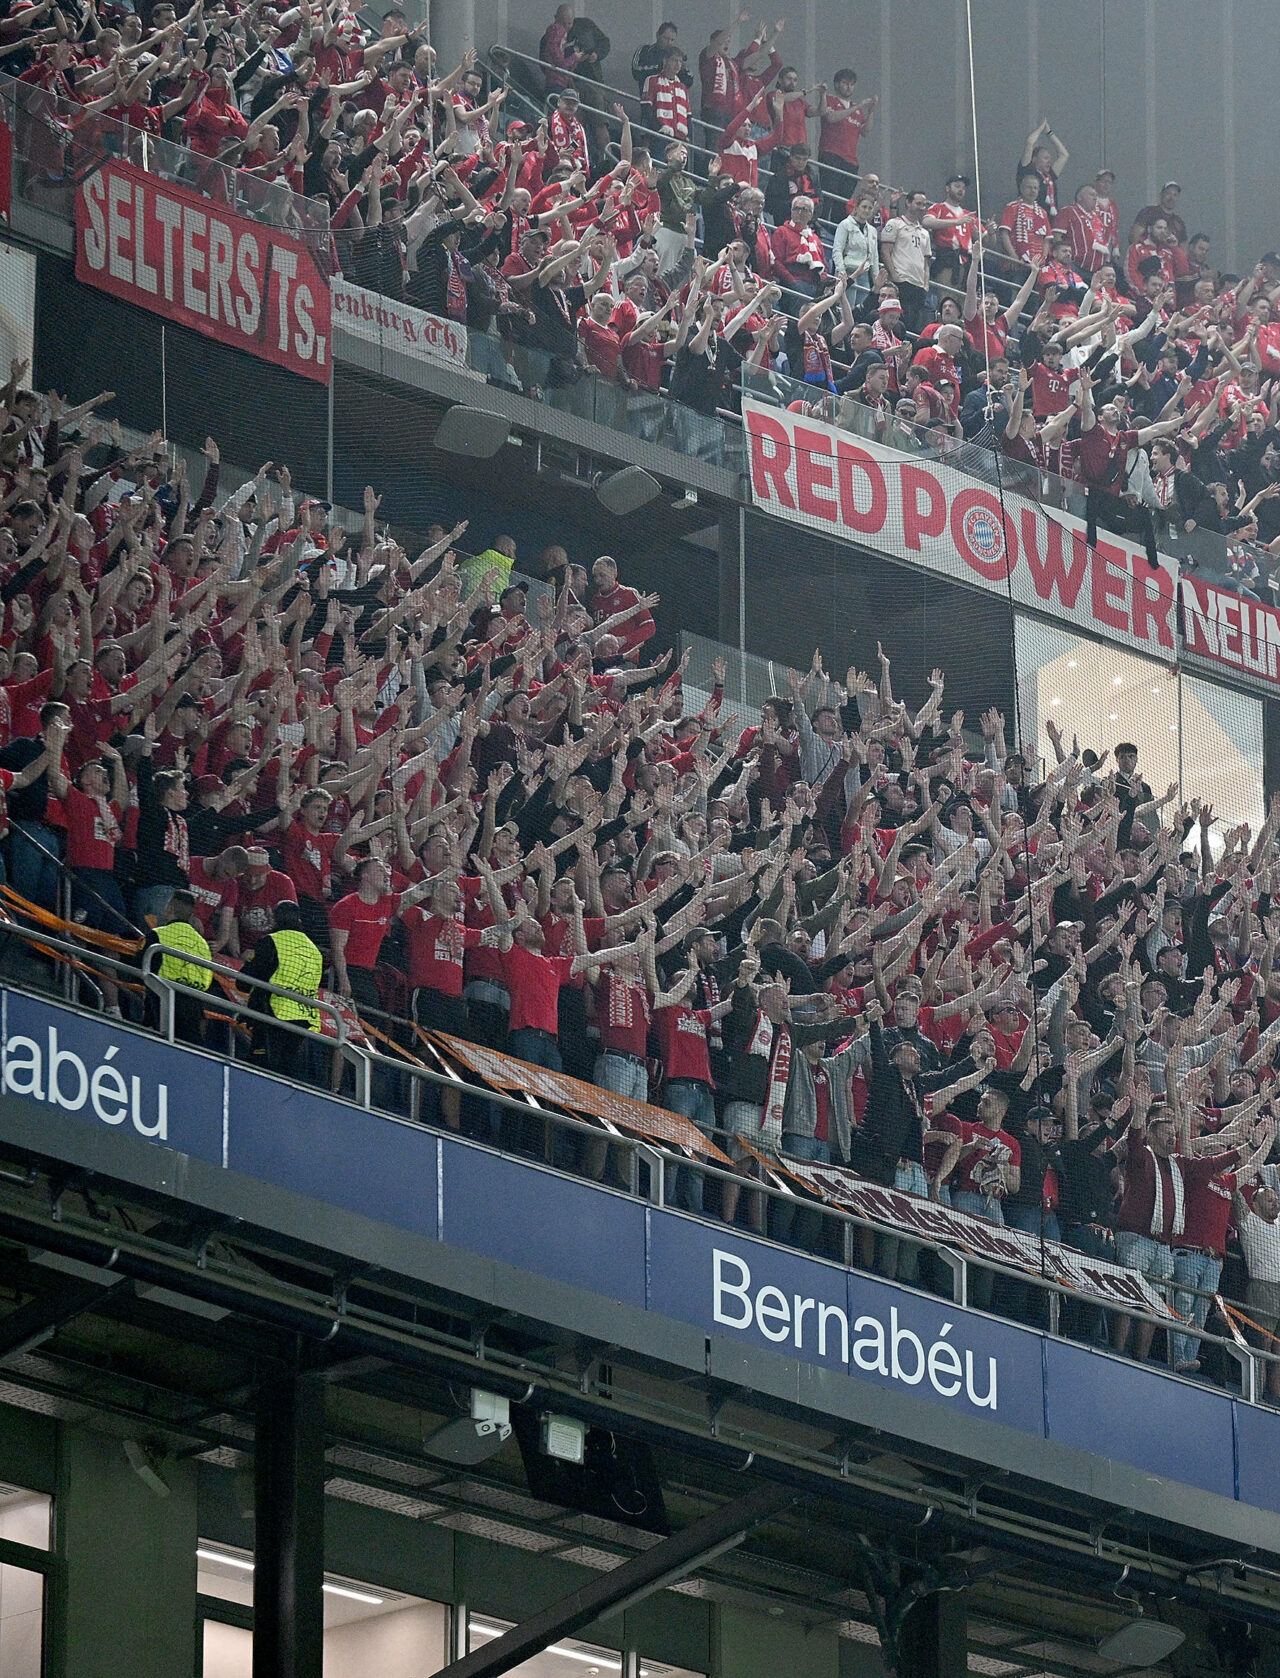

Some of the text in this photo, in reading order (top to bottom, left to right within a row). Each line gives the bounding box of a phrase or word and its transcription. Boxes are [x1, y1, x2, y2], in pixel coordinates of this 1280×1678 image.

[746, 410, 1174, 650] RED POWER
[5, 1026, 168, 1141] abéu
[713, 1248, 998, 1411] Bernabéu
